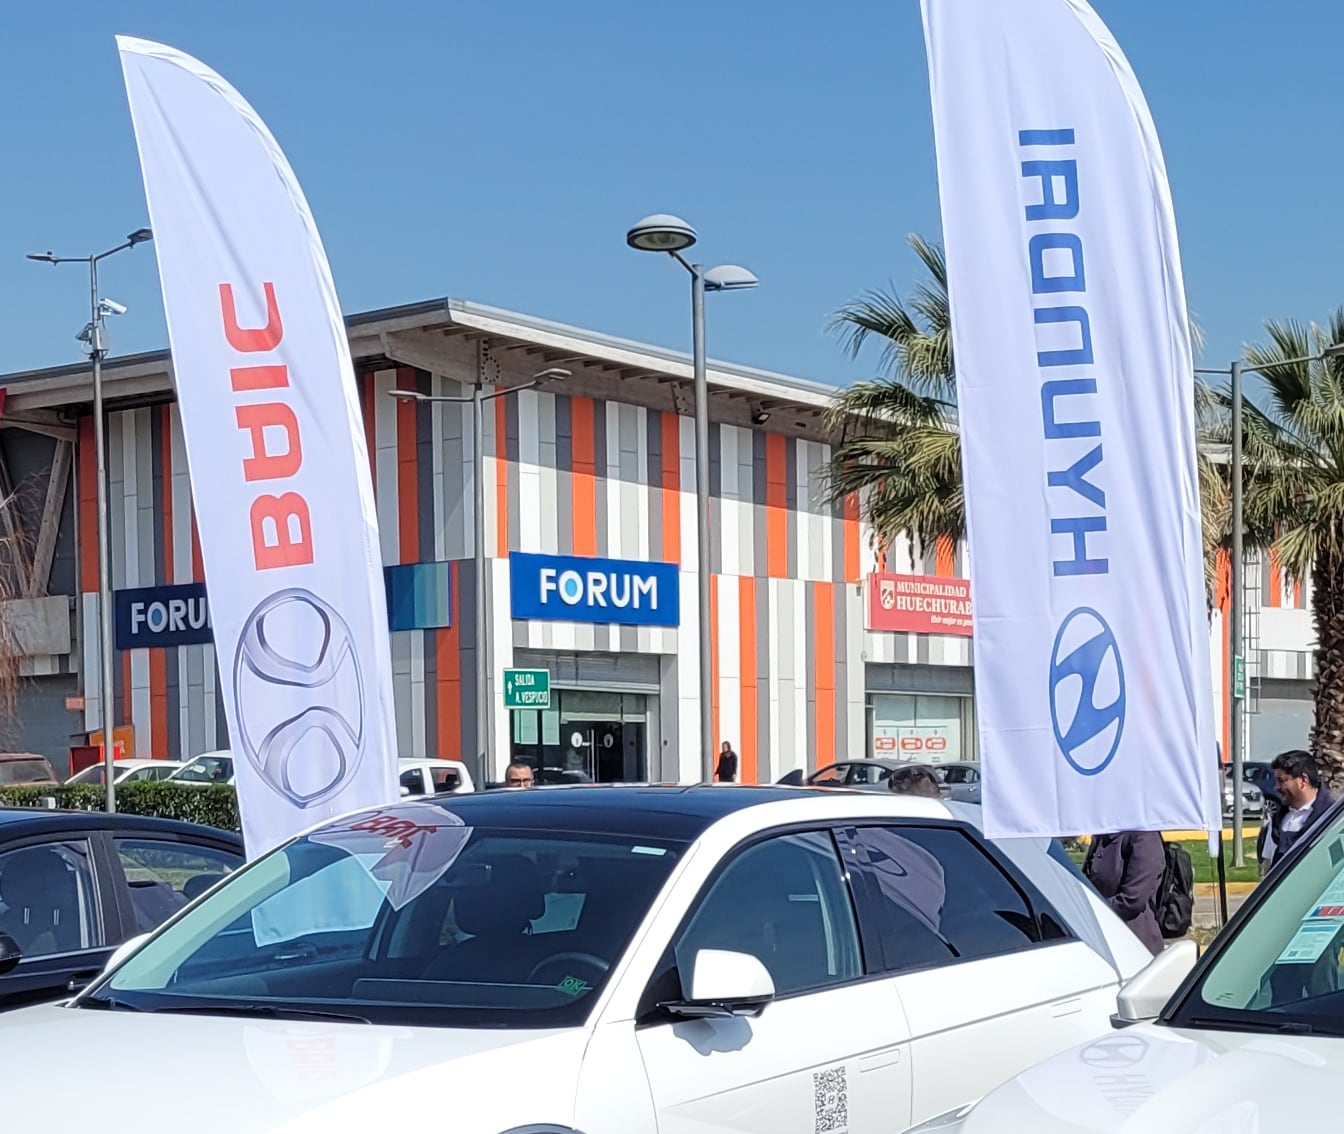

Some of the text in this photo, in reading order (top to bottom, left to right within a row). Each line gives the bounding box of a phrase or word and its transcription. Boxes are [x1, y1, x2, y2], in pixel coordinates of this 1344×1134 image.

[540, 568, 657, 610] FORUM
[896, 581, 967, 598] MUNICIPALIDAD
[131, 598, 212, 634] FORU
[515, 673, 535, 686] SALIDA
[564, 979, 583, 991] OK
